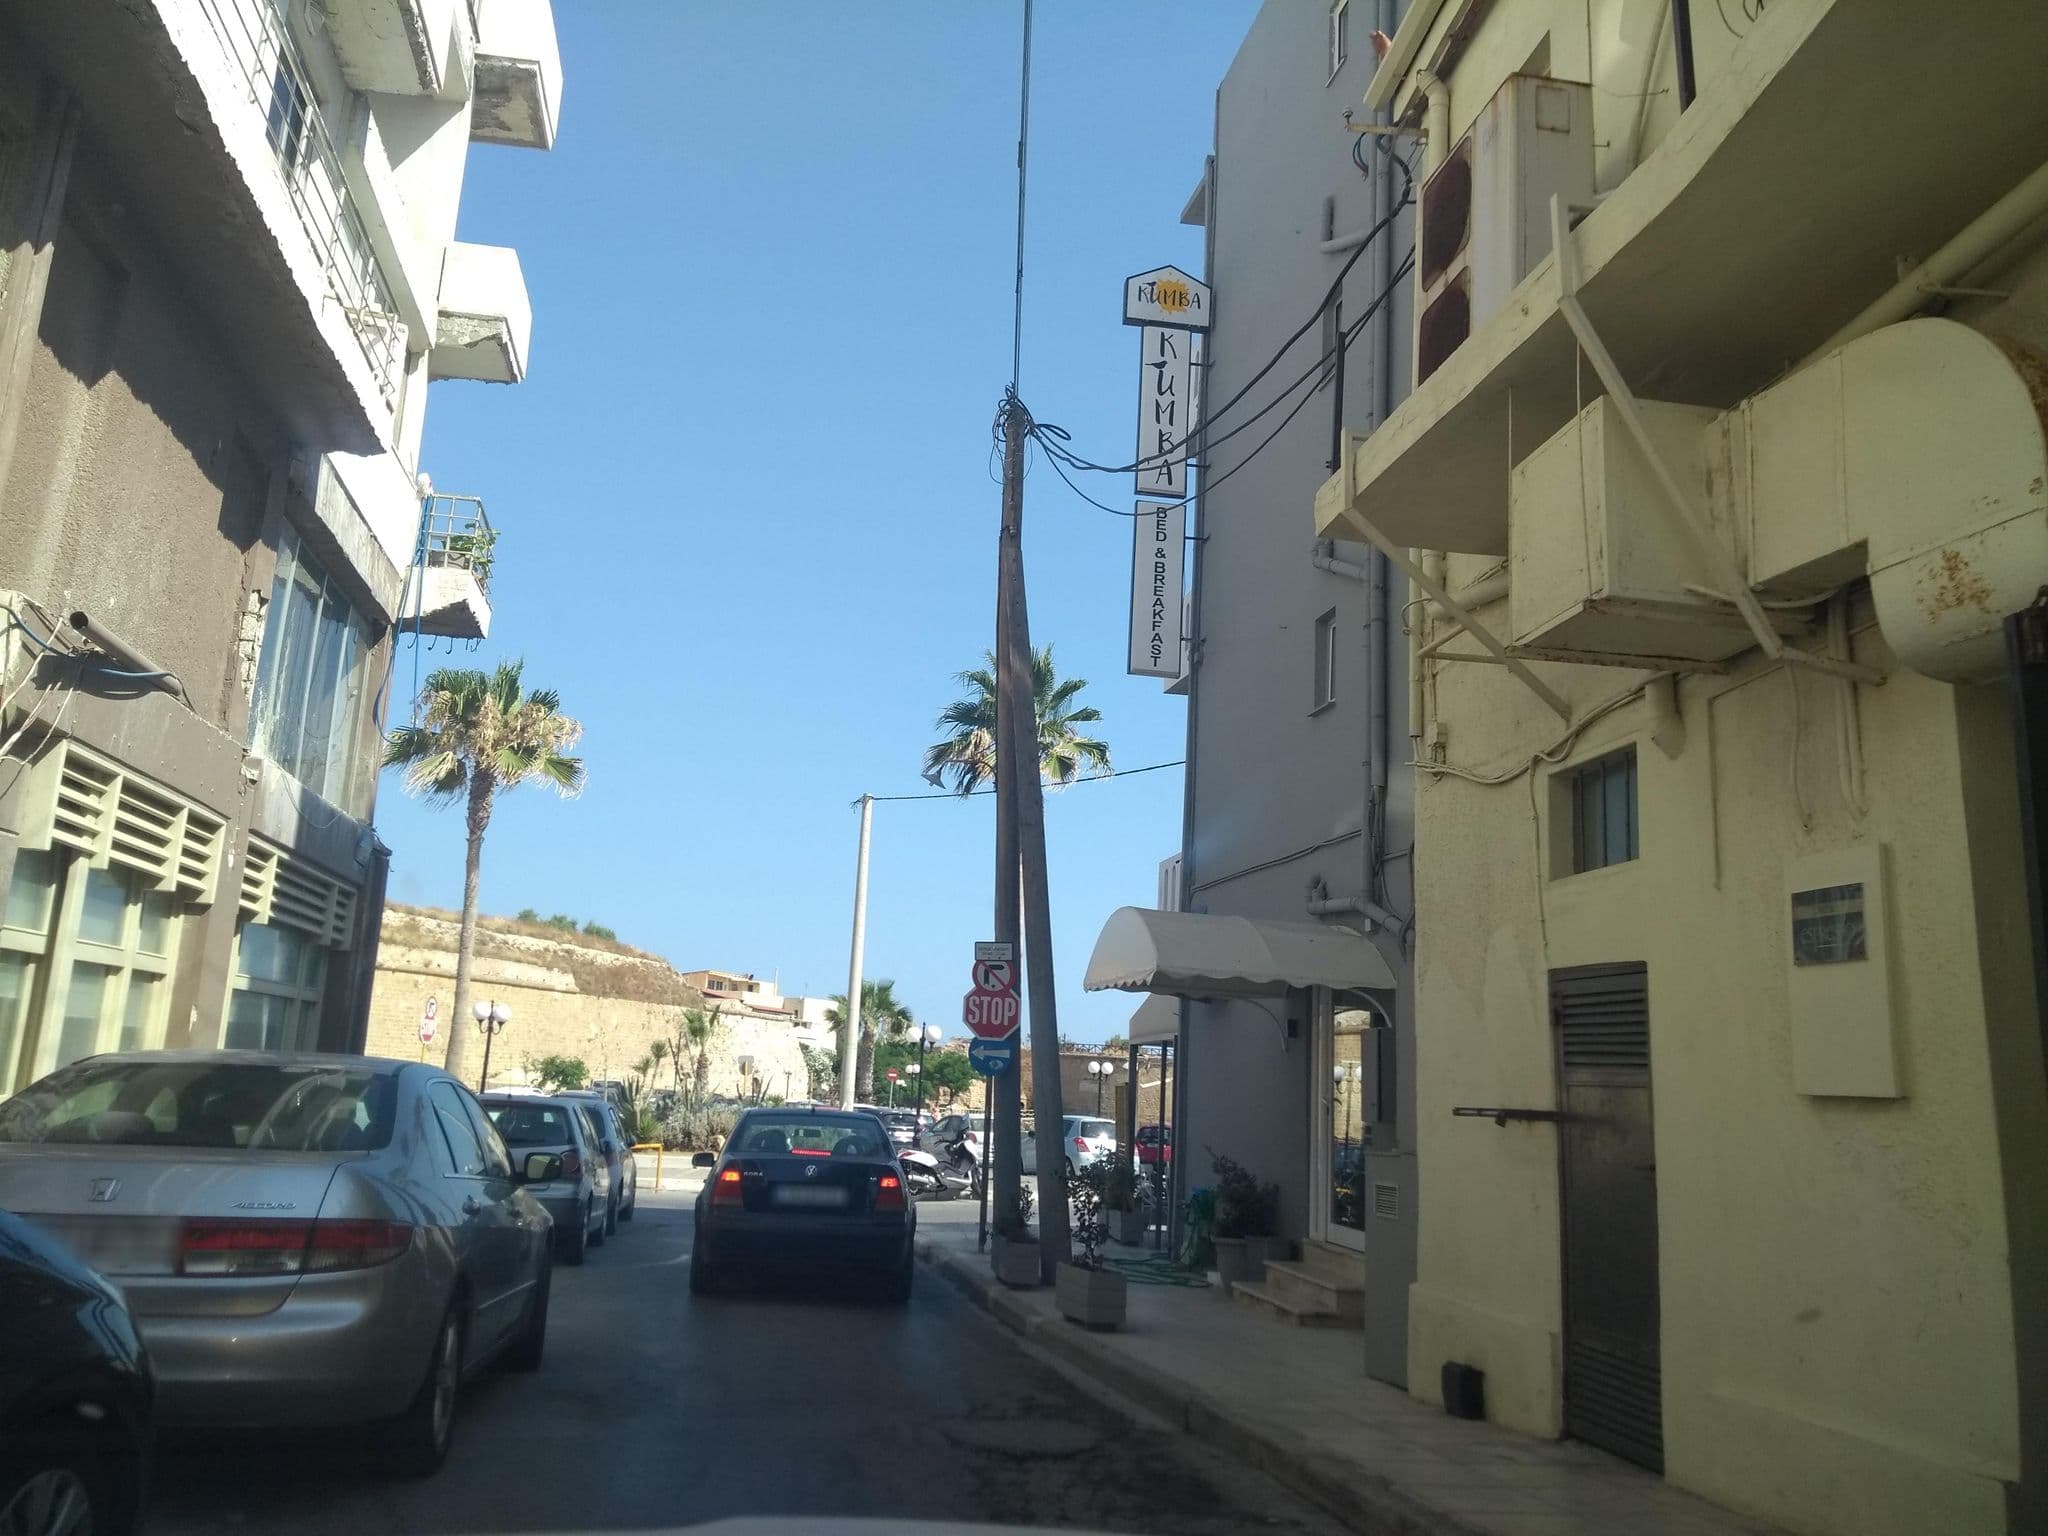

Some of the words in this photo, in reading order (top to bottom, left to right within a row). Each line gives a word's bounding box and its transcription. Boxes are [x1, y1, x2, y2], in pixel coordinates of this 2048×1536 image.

[1138, 281, 1201, 310] KUMBA
[1154, 331, 1177, 486] KUMBA
[1155, 507, 1168, 542] BED
[1154, 547, 1167, 560] &
[1150, 561, 1167, 668] BREAKFAST
[967, 996, 1017, 1026] STOP
